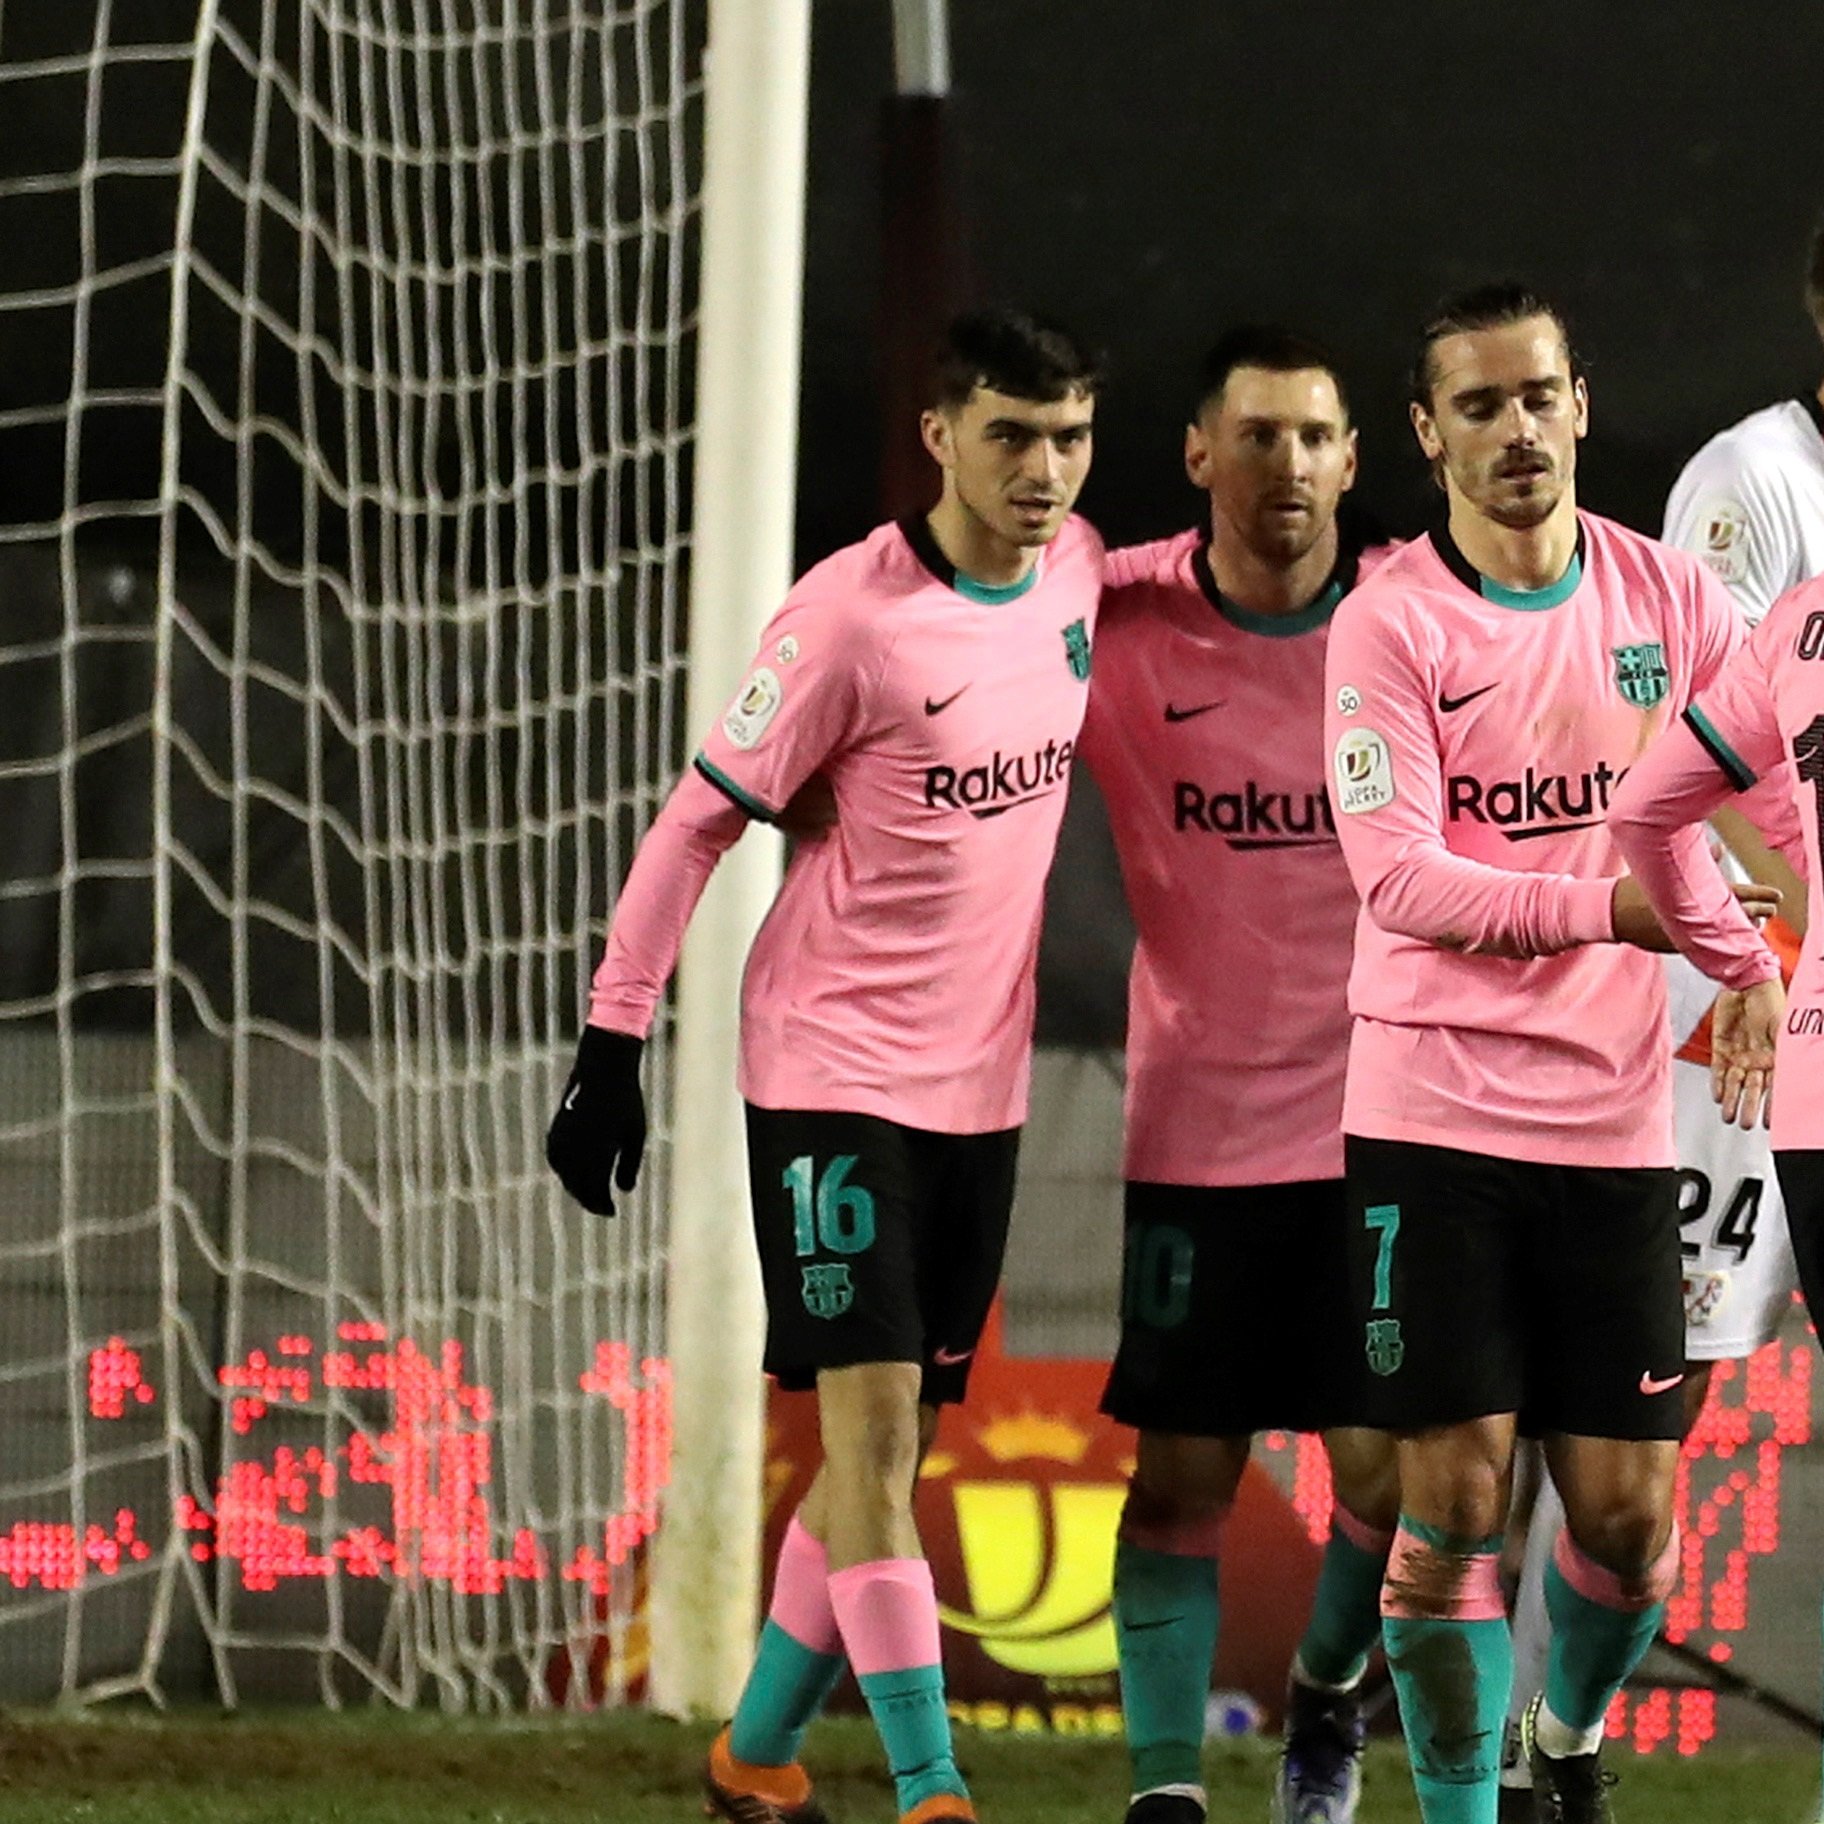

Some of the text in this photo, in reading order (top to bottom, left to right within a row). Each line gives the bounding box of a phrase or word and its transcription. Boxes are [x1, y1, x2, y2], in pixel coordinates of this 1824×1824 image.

[1448, 761, 1631, 825] Rakut
[782, 1155, 876, 1256] 16
[1678, 1168, 1764, 1263] 24
[1364, 1204, 1400, 1309] 7
